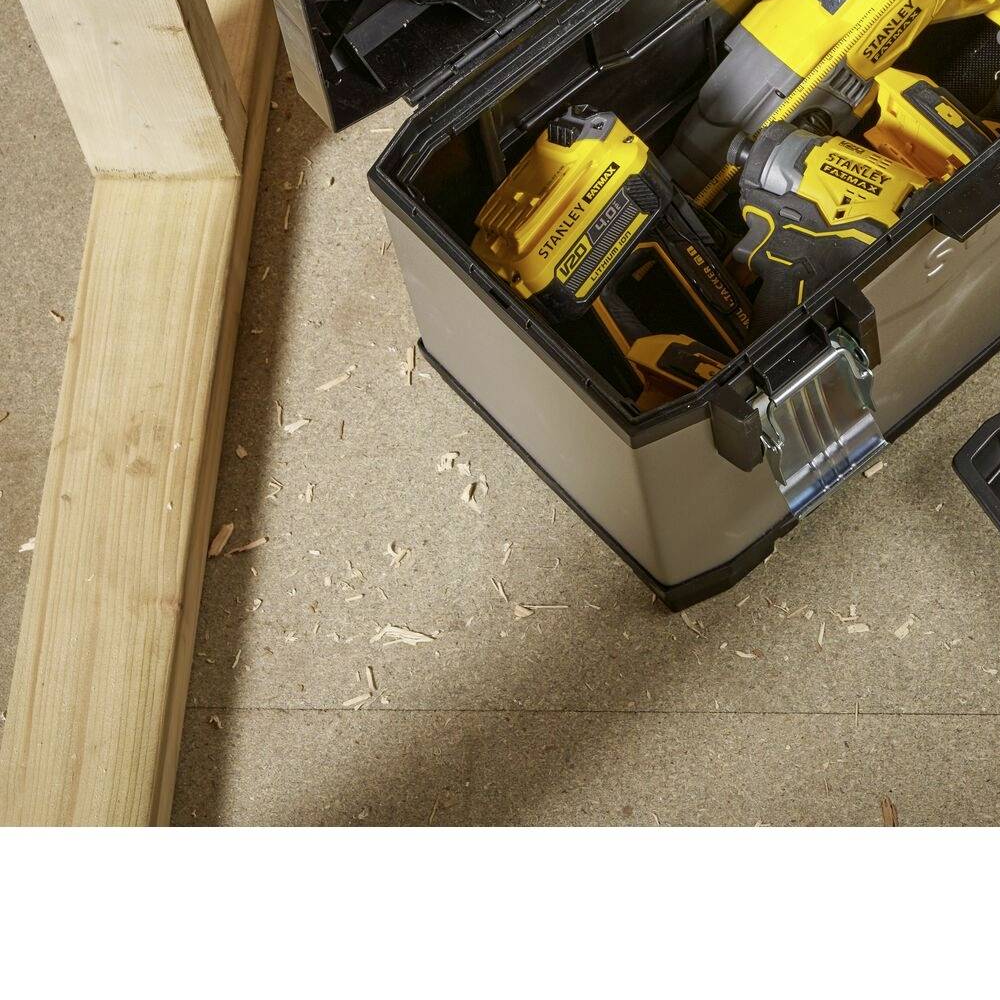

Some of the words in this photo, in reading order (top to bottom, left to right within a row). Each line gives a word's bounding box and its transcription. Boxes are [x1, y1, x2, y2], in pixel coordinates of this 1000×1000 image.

[863, 0, 915, 59] STANLEY
[823, 165, 879, 194] FATMAX
[826, 153, 891, 184] STANLEY
[538, 202, 585, 259] STANLEY
[586, 165, 617, 201] FATMAX
[559, 242, 588, 277] V20
[594, 207, 618, 231] 4.0
